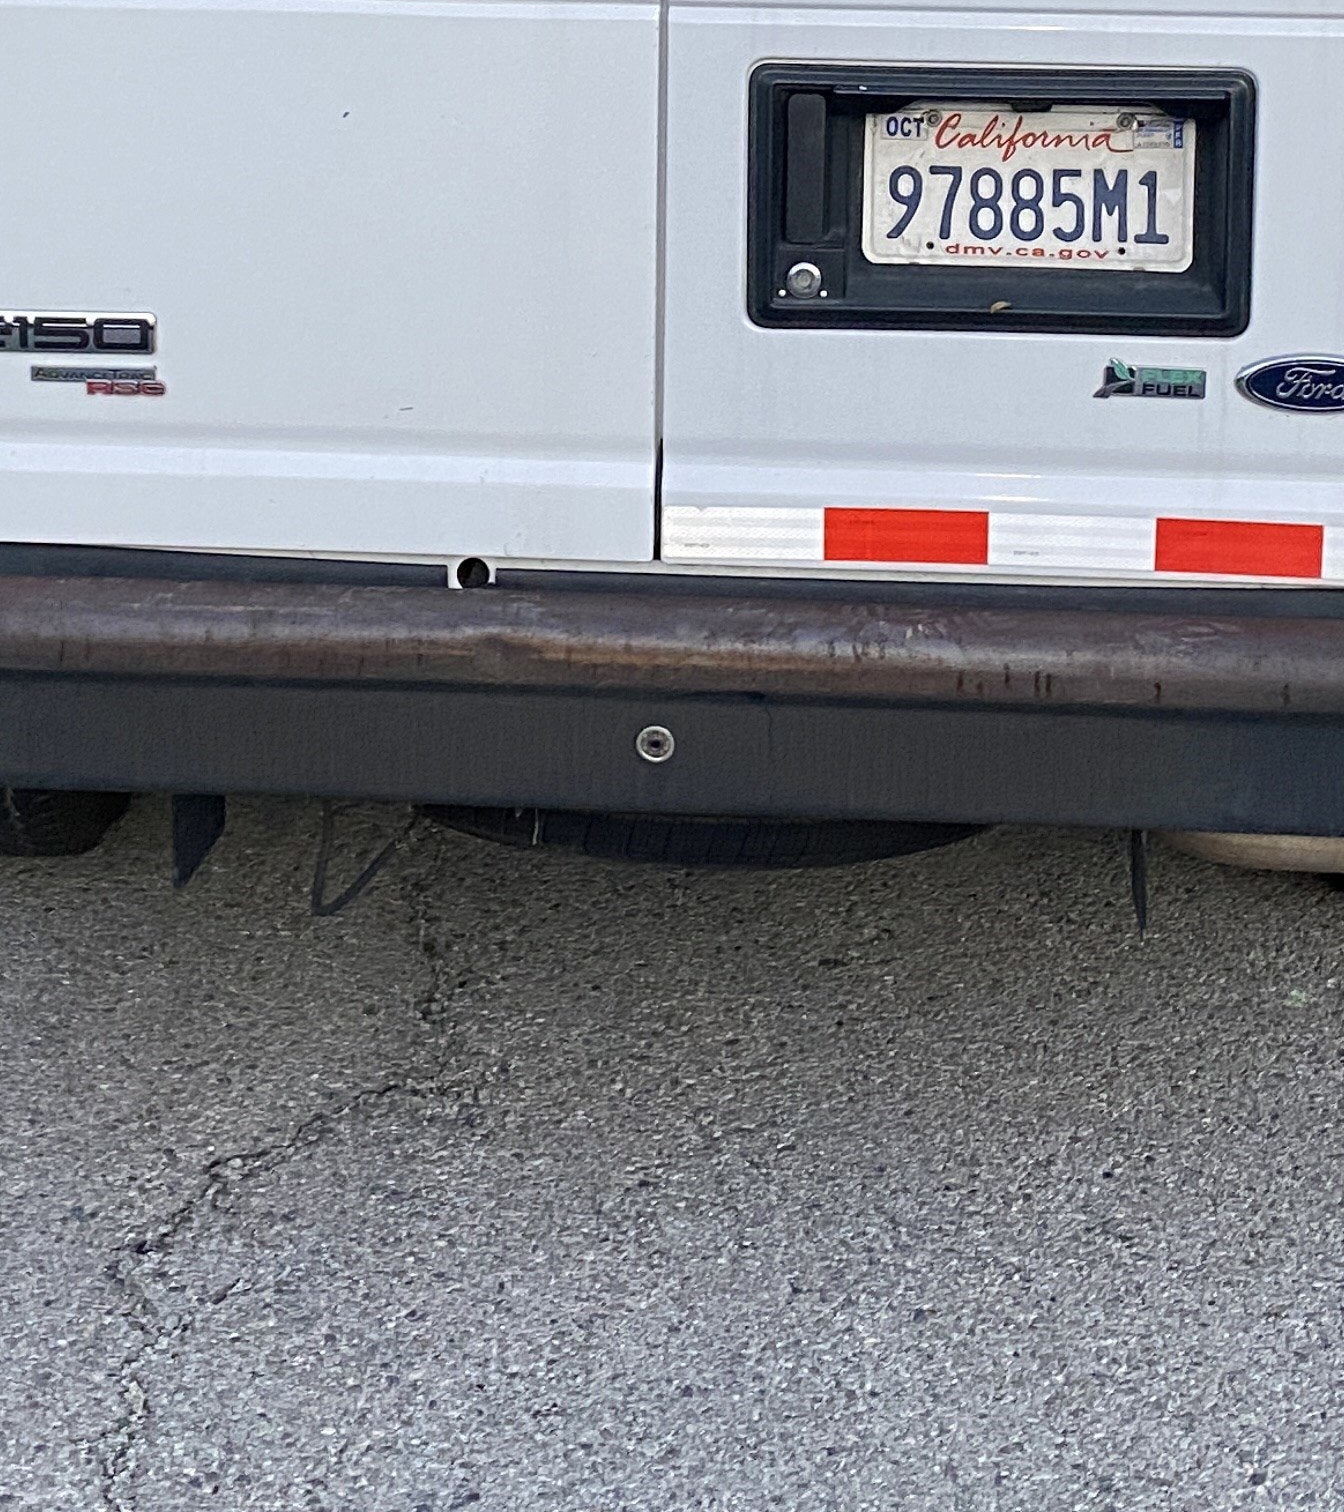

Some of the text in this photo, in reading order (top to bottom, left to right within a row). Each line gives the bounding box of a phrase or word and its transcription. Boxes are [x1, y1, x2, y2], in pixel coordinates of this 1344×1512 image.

[886, 116, 923, 137] OCT
[935, 114, 1134, 161] California
[887, 165, 1170, 245] 97885M1
[945, 242, 1110, 261] dmv.ca.gov
[86, 379, 166, 396] RSC
[1141, 383, 1200, 398] FUEL
